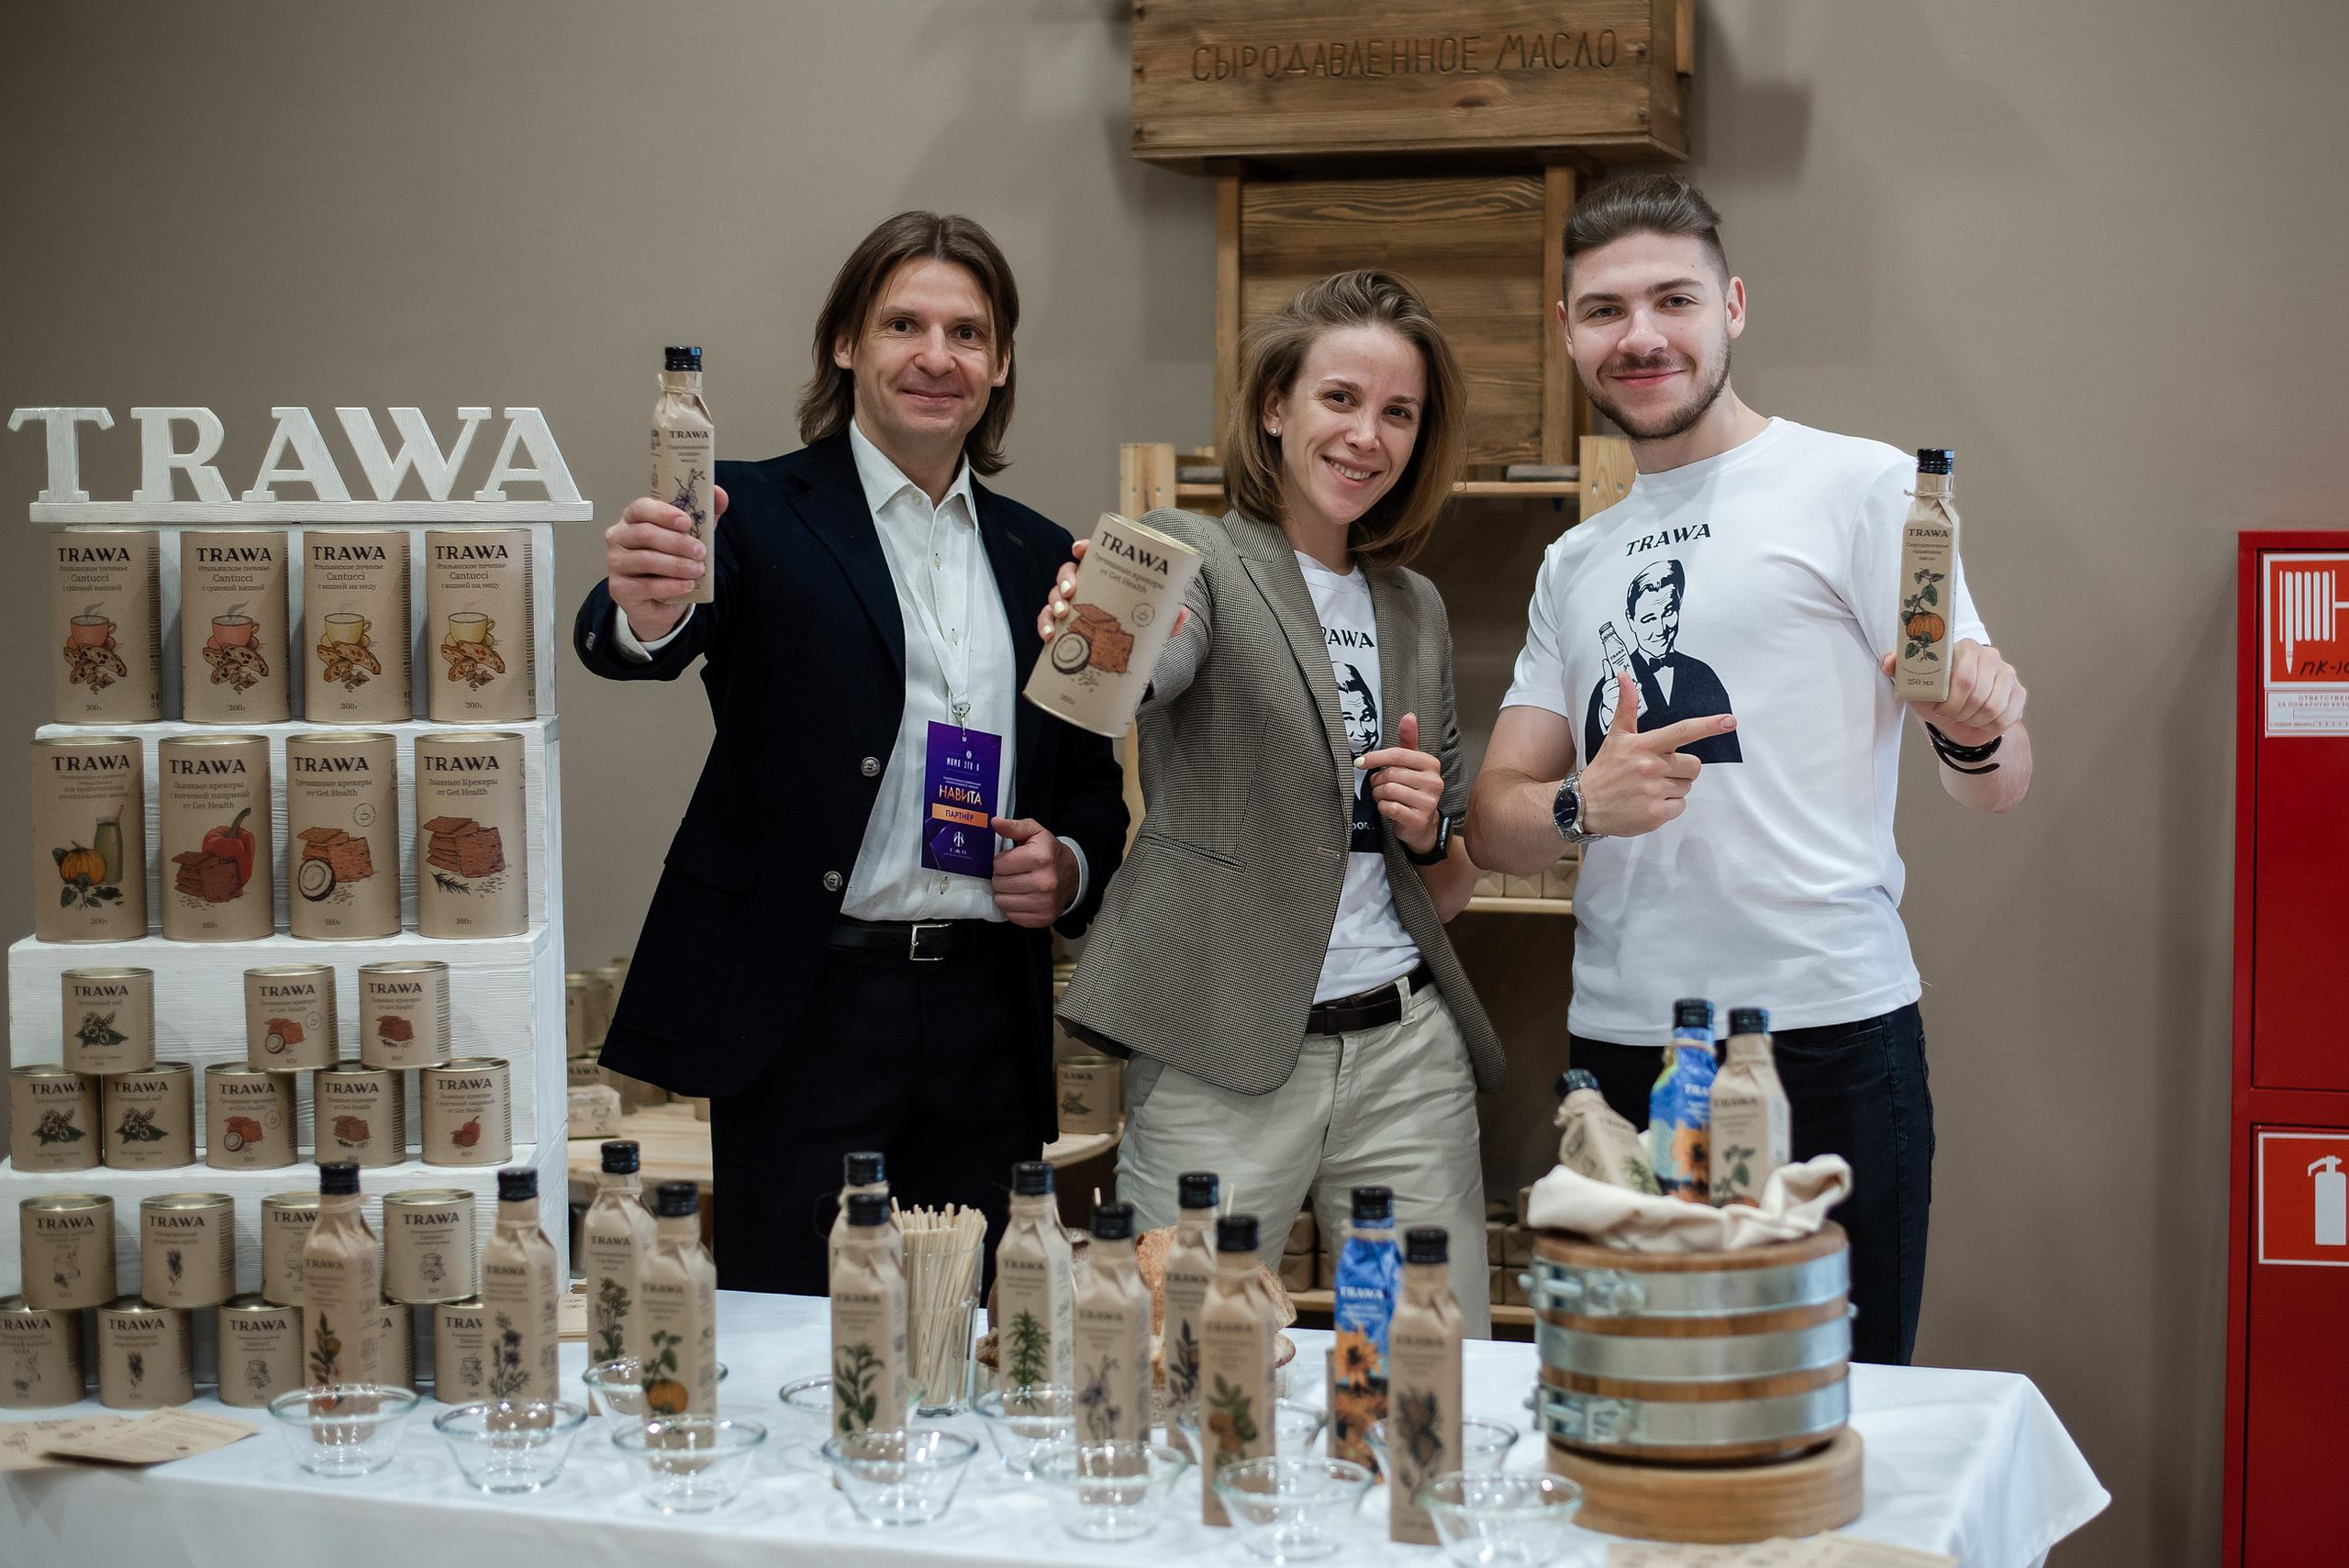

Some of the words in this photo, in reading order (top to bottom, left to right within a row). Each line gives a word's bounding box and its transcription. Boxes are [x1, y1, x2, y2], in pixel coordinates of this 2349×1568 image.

[1192, 37, 1482, 82] СЫРОДАВЛЕННОЕ
[1495, 29, 1617, 72] МАСЛО
[7, 406, 584, 503] TRAWA
[1909, 528, 1948, 538] TRAWA
[1626, 523, 1711, 557] TRAWA
[58, 548, 130, 562] TRAWA
[196, 548, 272, 562] TRAWA
[313, 546, 386, 561] TRAWA
[435, 545, 508, 560] TRAWA
[1101, 532, 1169, 575] TRAWA
[213, 574, 253, 583] Cantucci
[327, 572, 365, 581] Cantucci
[450, 572, 489, 581] Cantucci
[1108, 571, 1123, 583] Get
[1122, 576, 1147, 595] Health
[51, 754, 130, 772] TRAWA
[169, 759, 246, 775] TRAWA
[294, 757, 369, 772] TRAWA
[424, 756, 499, 771] TRAWA
[208, 782, 244, 791] крекеры
[447, 787, 459, 796] Get
[939, 784, 982, 806] НАВИТА
[208, 801, 234, 809] Health
[946, 809, 974, 821] ПАРТНЁР
[72, 985, 128, 996] TRAWA
[259, 984, 316, 997] TRAWA
[369, 983, 422, 995] TRAWA
[29, 1081, 86, 1095] TRAWA
[113, 1081, 169, 1094] TRAWA
[219, 1083, 275, 1095] TRAWA
[325, 1082, 380, 1094] TRAWA
[437, 1078, 492, 1090] TRAWA
[36, 1217, 95, 1229] TRAWA
[149, 1216, 206, 1228] TRAWA
[403, 1213, 460, 1226] TRAWA
[591, 1235, 630, 1246] TRAWA
[108, 1318, 165, 1330] TRAWA
[229, 1319, 287, 1330] TRAWA
